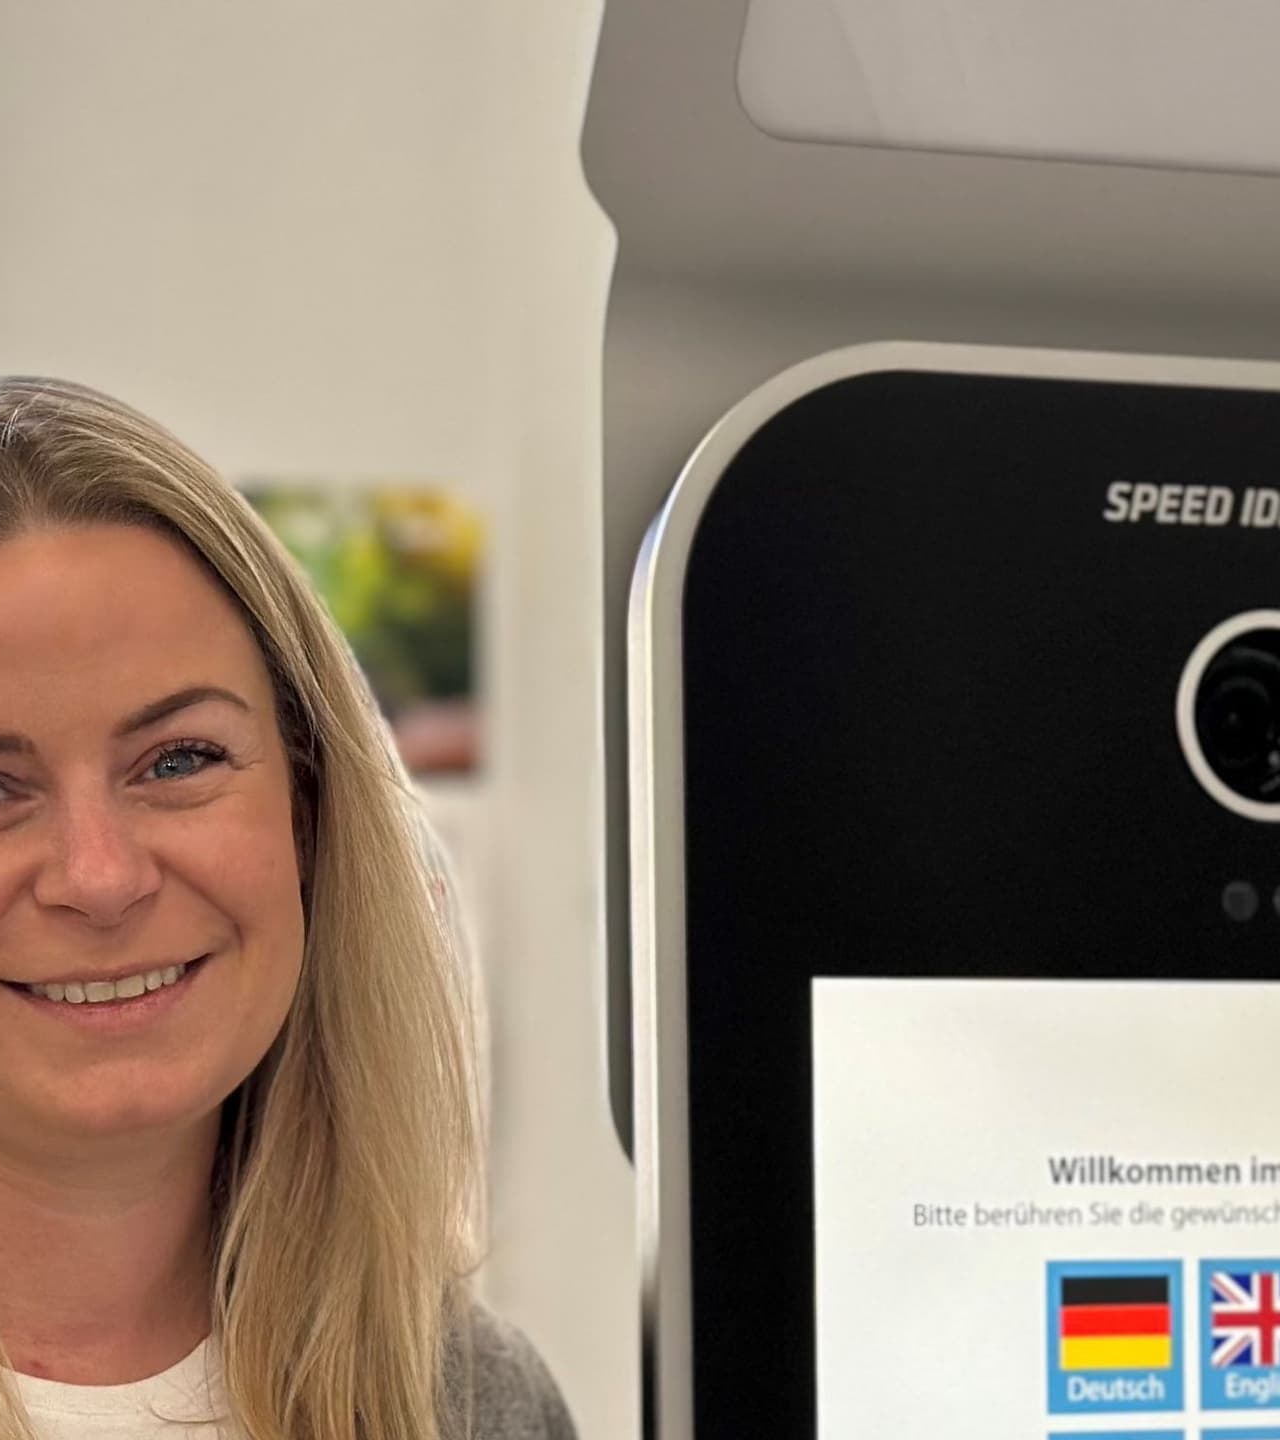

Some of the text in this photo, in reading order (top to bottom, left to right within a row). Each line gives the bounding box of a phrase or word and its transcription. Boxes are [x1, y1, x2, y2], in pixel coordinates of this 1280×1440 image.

[1102, 481, 1234, 527] SPEED
[1048, 1156, 1242, 1185] Willkommen
[913, 1203, 967, 1227] Bitte
[974, 1201, 1083, 1226] berühren
[1089, 1201, 1121, 1225] Sie
[1129, 1201, 1165, 1225] die
[1066, 1375, 1166, 1402] Deutsch
